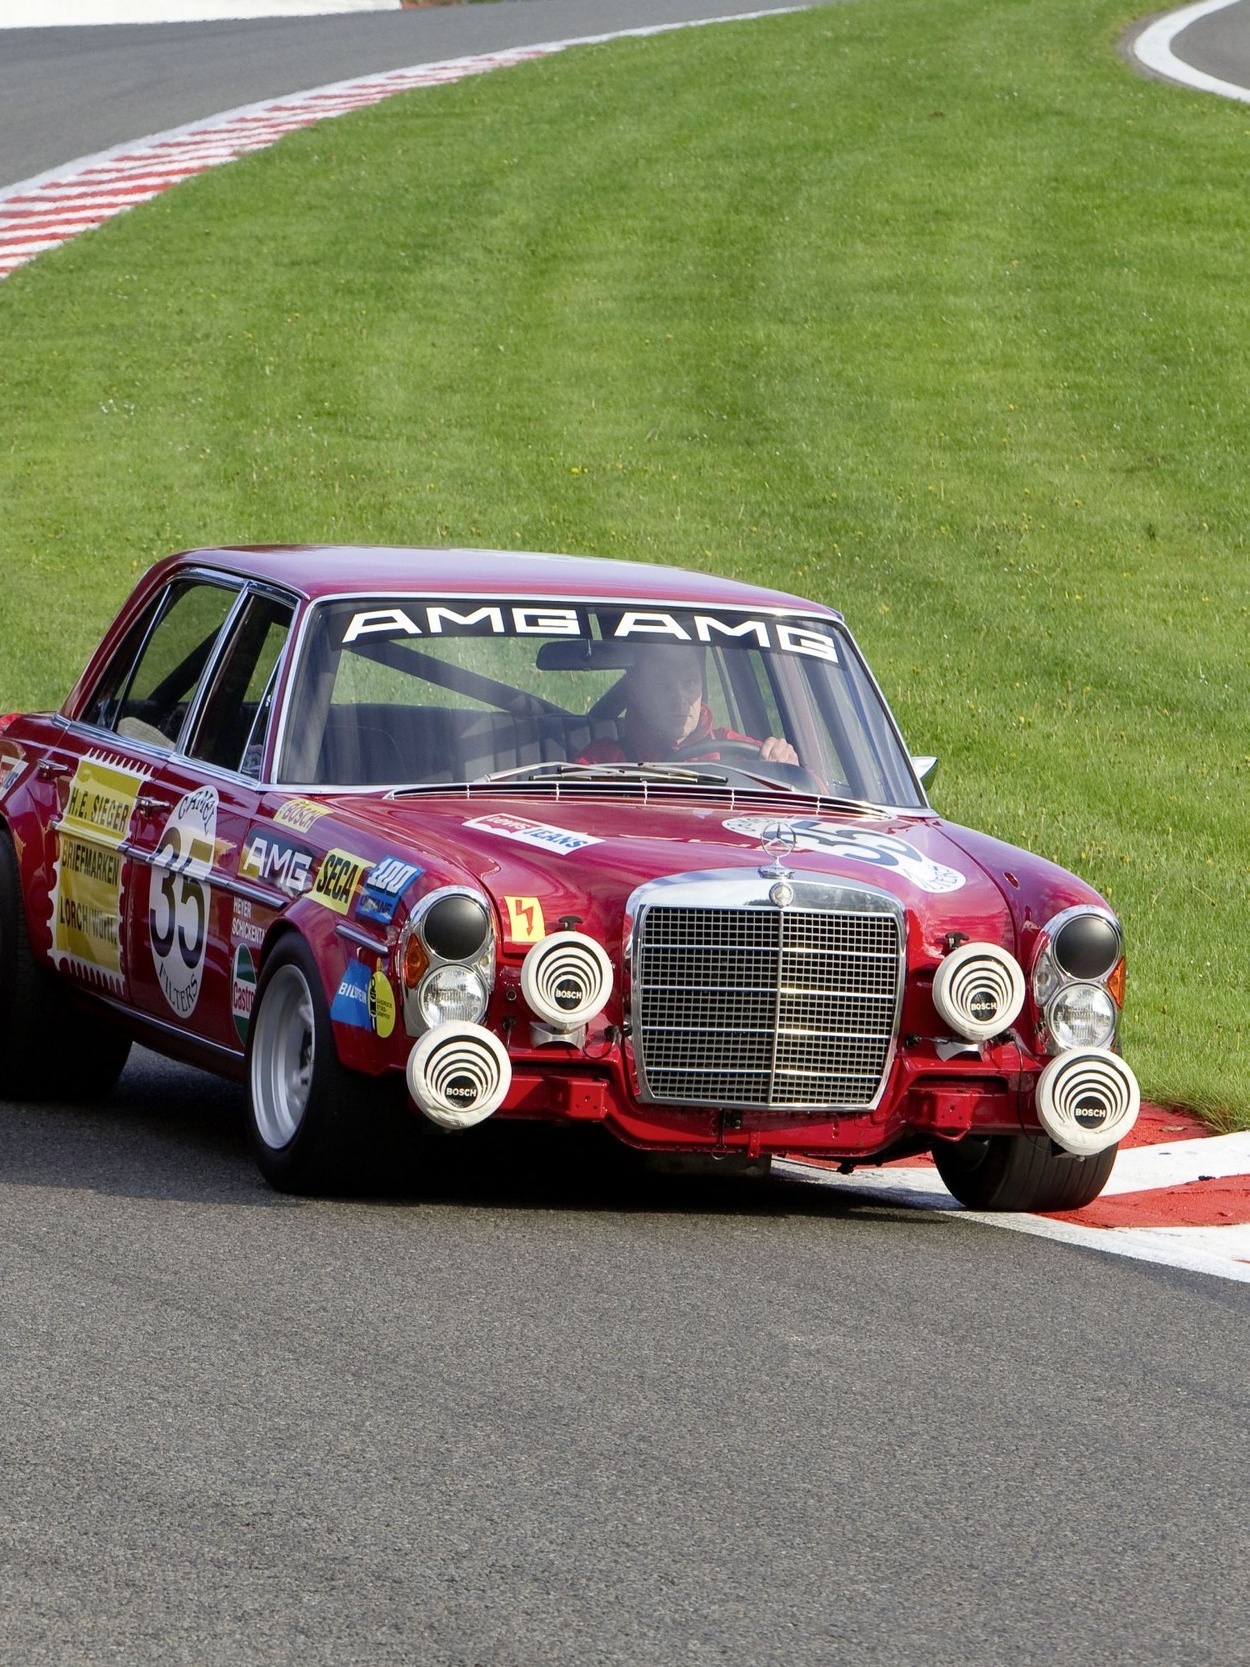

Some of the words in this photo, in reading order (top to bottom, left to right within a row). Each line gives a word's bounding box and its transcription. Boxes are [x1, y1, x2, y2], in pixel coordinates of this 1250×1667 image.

[341, 606, 581, 644] AMG
[613, 611, 839, 664] AMG
[68, 786, 89, 820] H.E.
[90, 794, 130, 834] SIEGER
[178, 790, 216, 837] CAMEL
[281, 802, 321, 830] BOSCH
[522, 828, 589, 848] JEANS
[61, 838, 120, 888] BRIEFMARKEN
[242, 836, 313, 892] AMG
[315, 853, 359, 904] SECA
[366, 858, 418, 895] 100
[150, 826, 214, 970] 35
[158, 962, 200, 1013] FILTERS
[555, 987, 583, 1000] BOSCH
[970, 1001, 998, 1011] BOSCH
[445, 1087, 478, 1098] BOSCH
[1074, 1107, 1106, 1118] BOSCH
